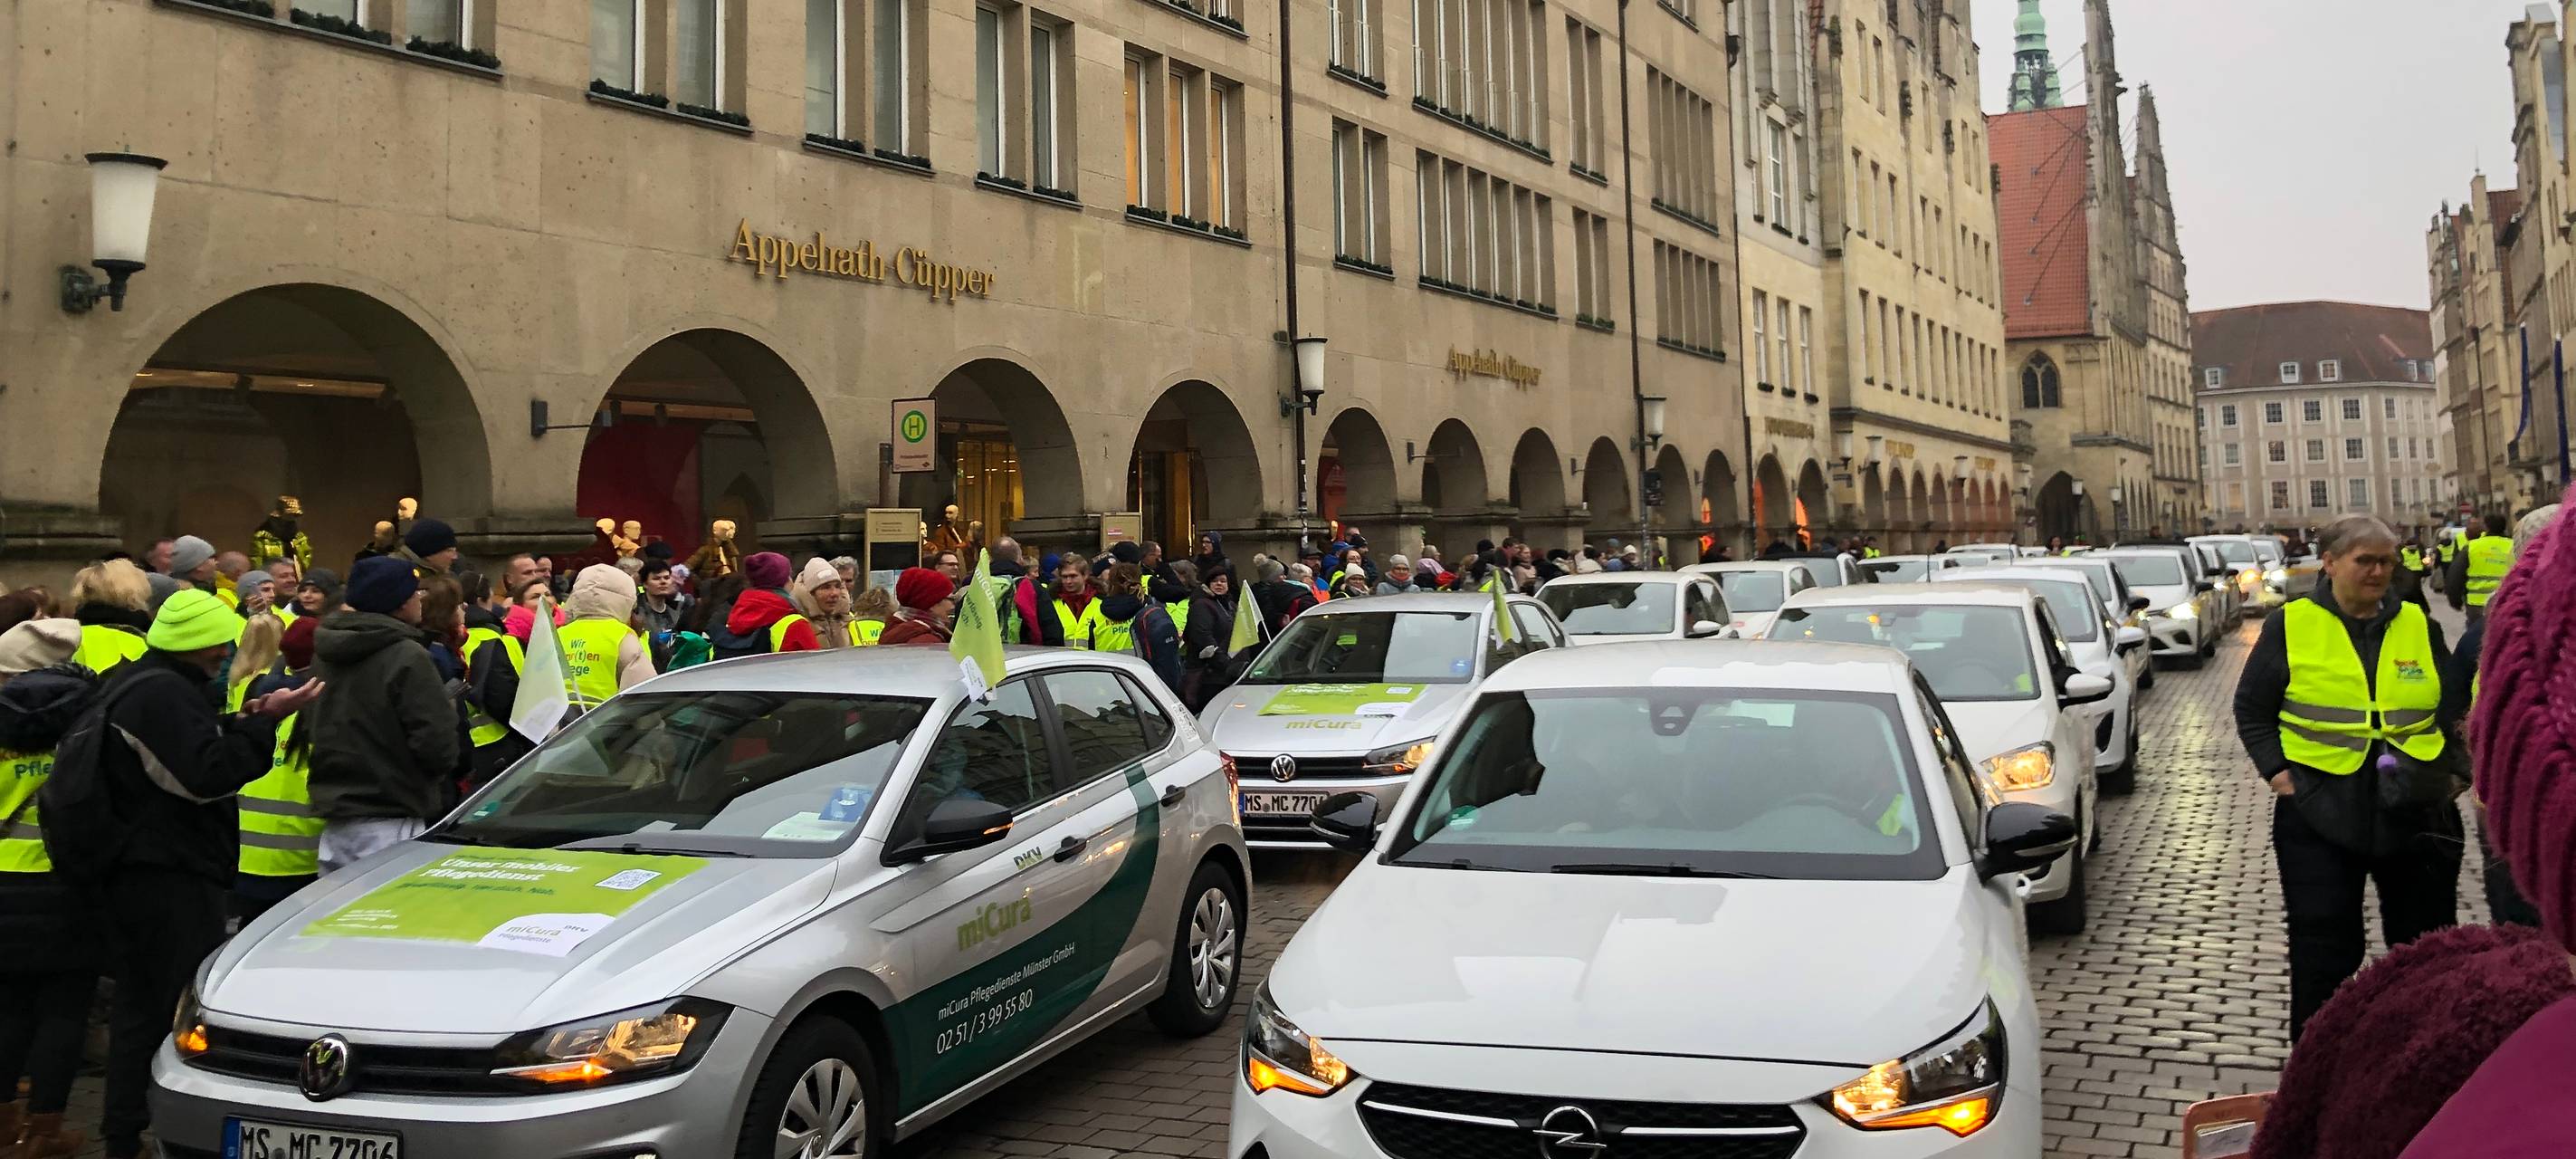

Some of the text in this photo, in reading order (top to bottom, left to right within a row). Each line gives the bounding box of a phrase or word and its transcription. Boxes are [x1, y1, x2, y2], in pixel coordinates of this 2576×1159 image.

[728, 217, 994, 301] Appelrath Cüpper
[570, 638, 586, 648] Wir
[14, 760, 54, 780] Pfle
[1245, 795, 1262, 811] MS
[1271, 795, 1289, 811] MC
[1013, 846, 1044, 870] DKV
[506, 925, 562, 936] miCura
[957, 897, 1032, 952] miCura
[938, 942, 1075, 1020] miCura Pflegedienste Münster GmbH
[936, 1029, 953, 1055] 02
[955, 1021, 968, 1046] 51
[978, 1012, 986, 1034] 3
[987, 1003, 1003, 1029] 99
[1005, 995, 1017, 1020] 55
[1018, 988, 1034, 1012] 80
[241, 1125, 271, 1159] MS
